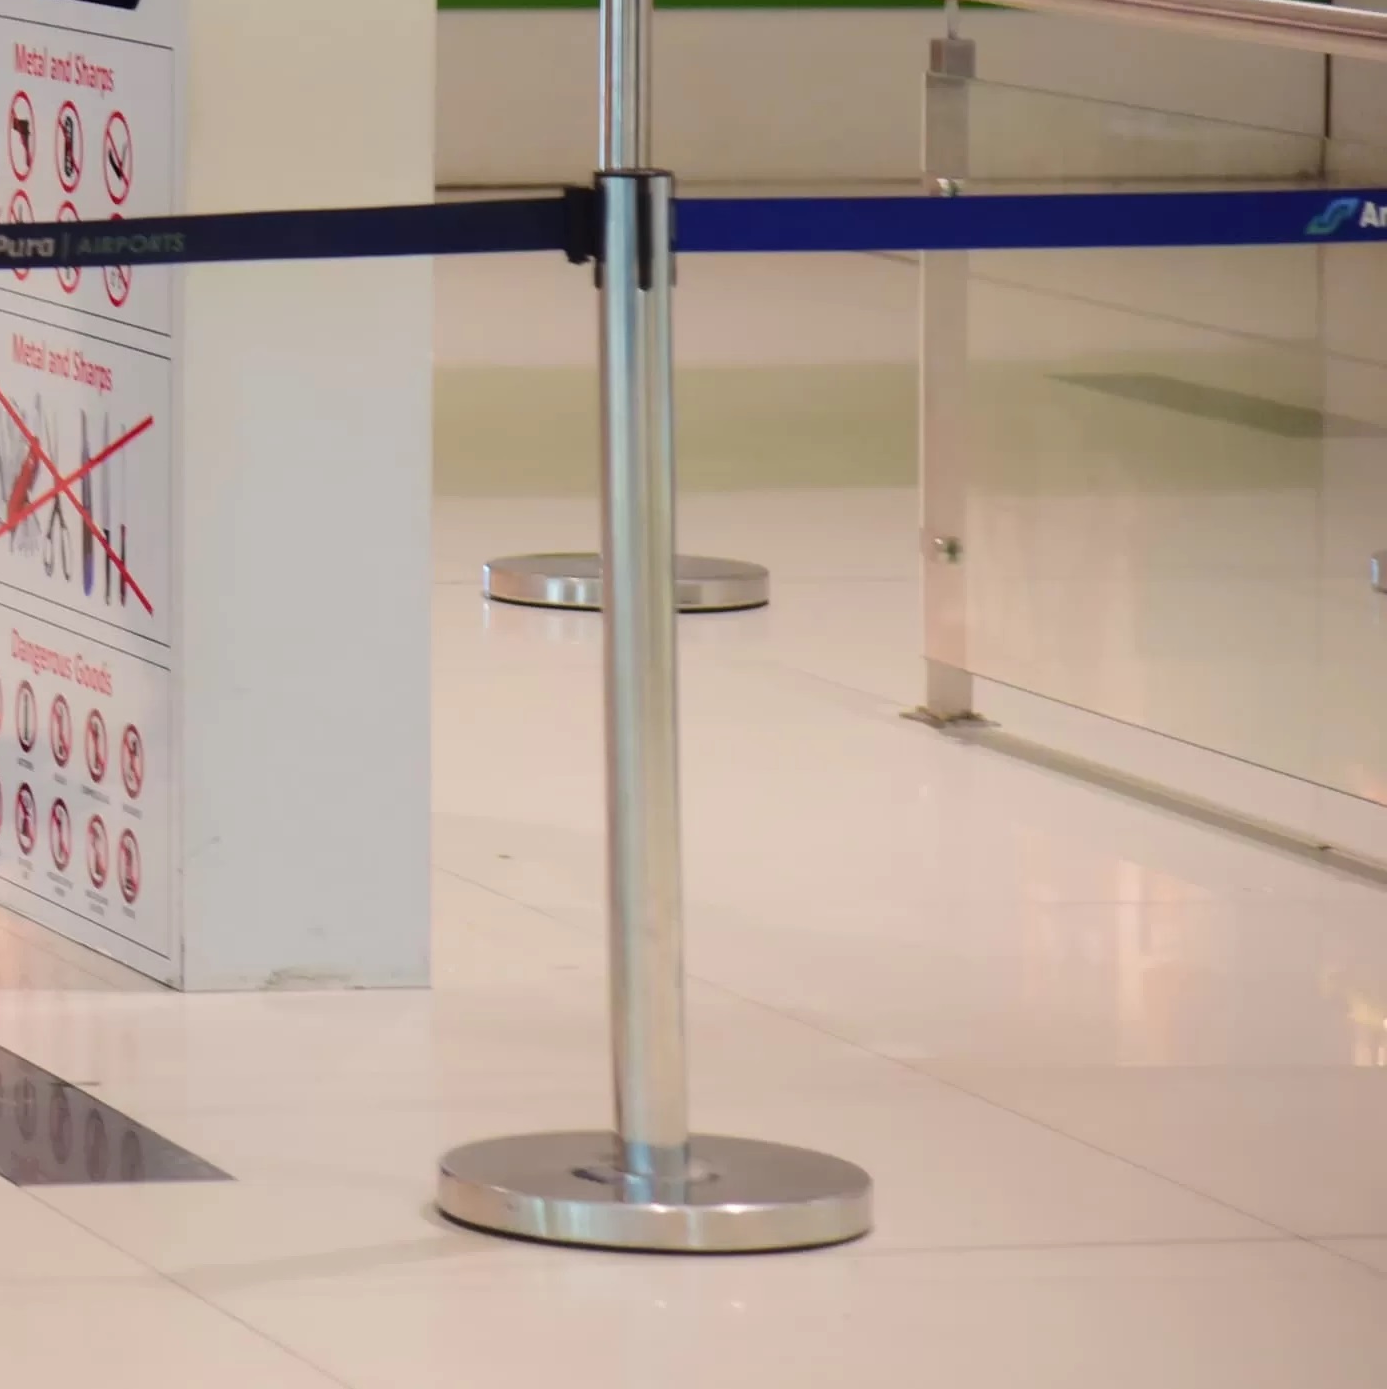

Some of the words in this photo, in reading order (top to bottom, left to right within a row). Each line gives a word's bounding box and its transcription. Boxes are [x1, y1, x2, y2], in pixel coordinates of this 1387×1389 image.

[14, 43, 48, 77] Metal
[50, 52, 72, 82] and
[74, 54, 115, 99] Sharps
[76, 231, 187, 256] AIRPORTS
[12, 333, 46, 372] Metal
[48, 347, 70, 378] and
[72, 351, 113, 396] Sharps
[10, 628, 73, 682] Dangerous
[75, 652, 115, 698] Goods
